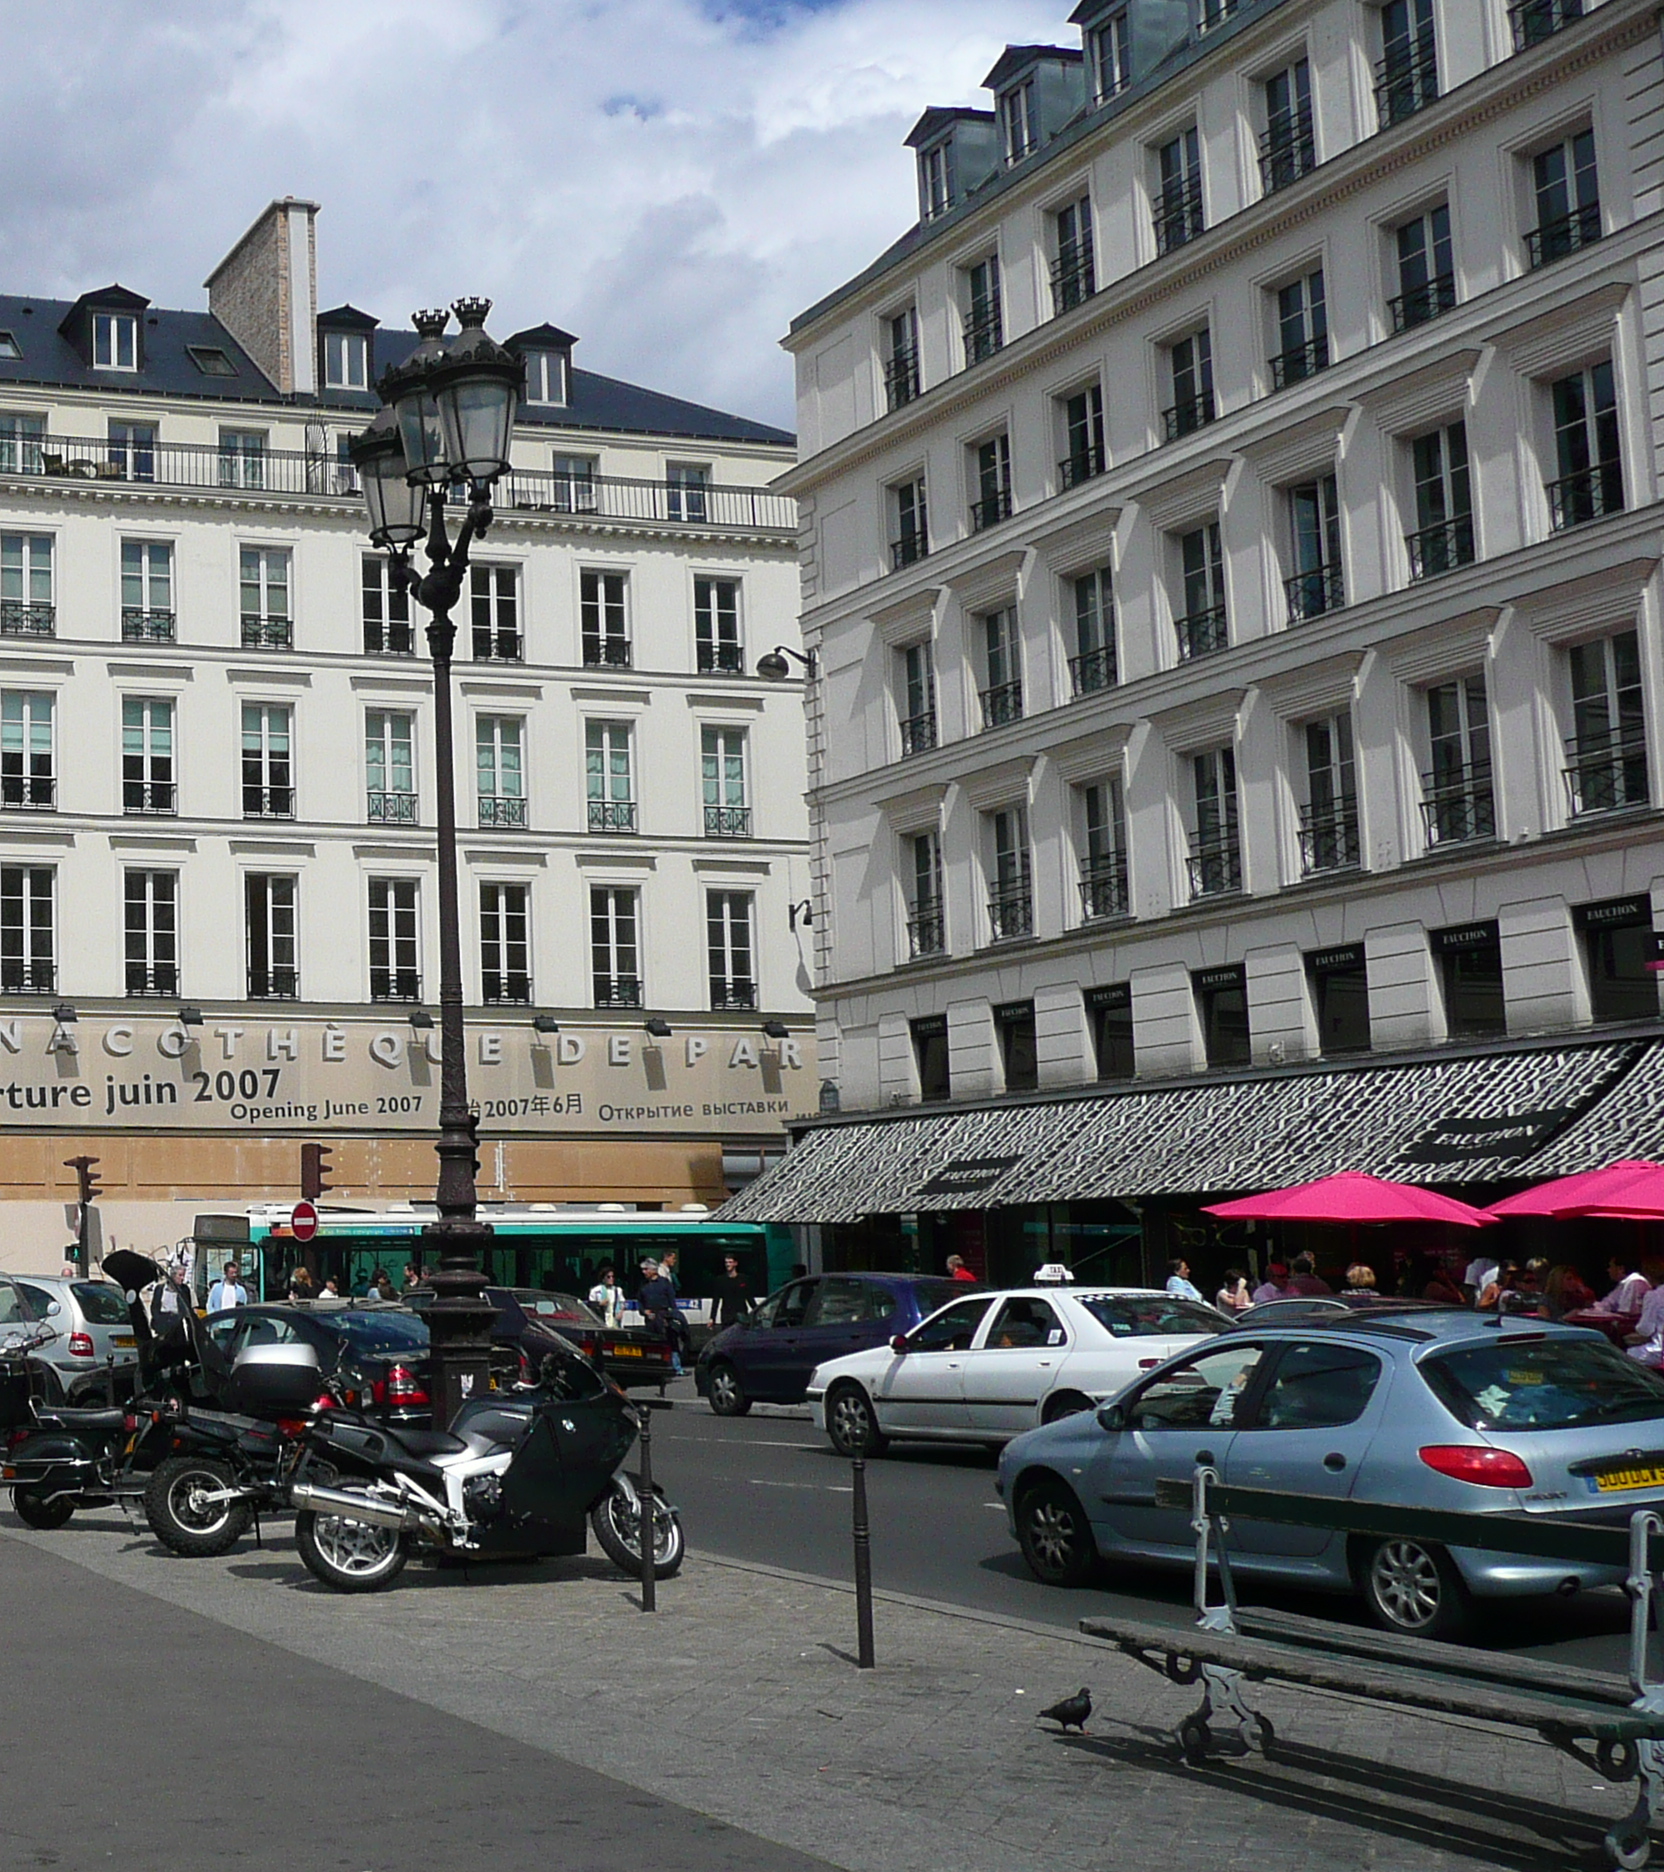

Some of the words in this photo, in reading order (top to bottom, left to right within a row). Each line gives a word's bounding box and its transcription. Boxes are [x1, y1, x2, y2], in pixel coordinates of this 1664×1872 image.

[1587, 904, 1637, 920] FAUCHON
[1443, 929, 1487, 944] FAUCHON
[1315, 952, 1356, 966] FAUCHON
[1202, 972, 1238, 984] FAUCHON
[557, 1034, 631, 1066] DE
[105, 1074, 177, 1116] juin
[192, 1069, 281, 1102] 2007
[231, 1101, 318, 1124] Opening
[323, 1100, 369, 1120] June
[377, 1096, 422, 1114] 2007
[1433, 1125, 1540, 1146] FAUCHON
[689, 1298, 699, 1309] 42
